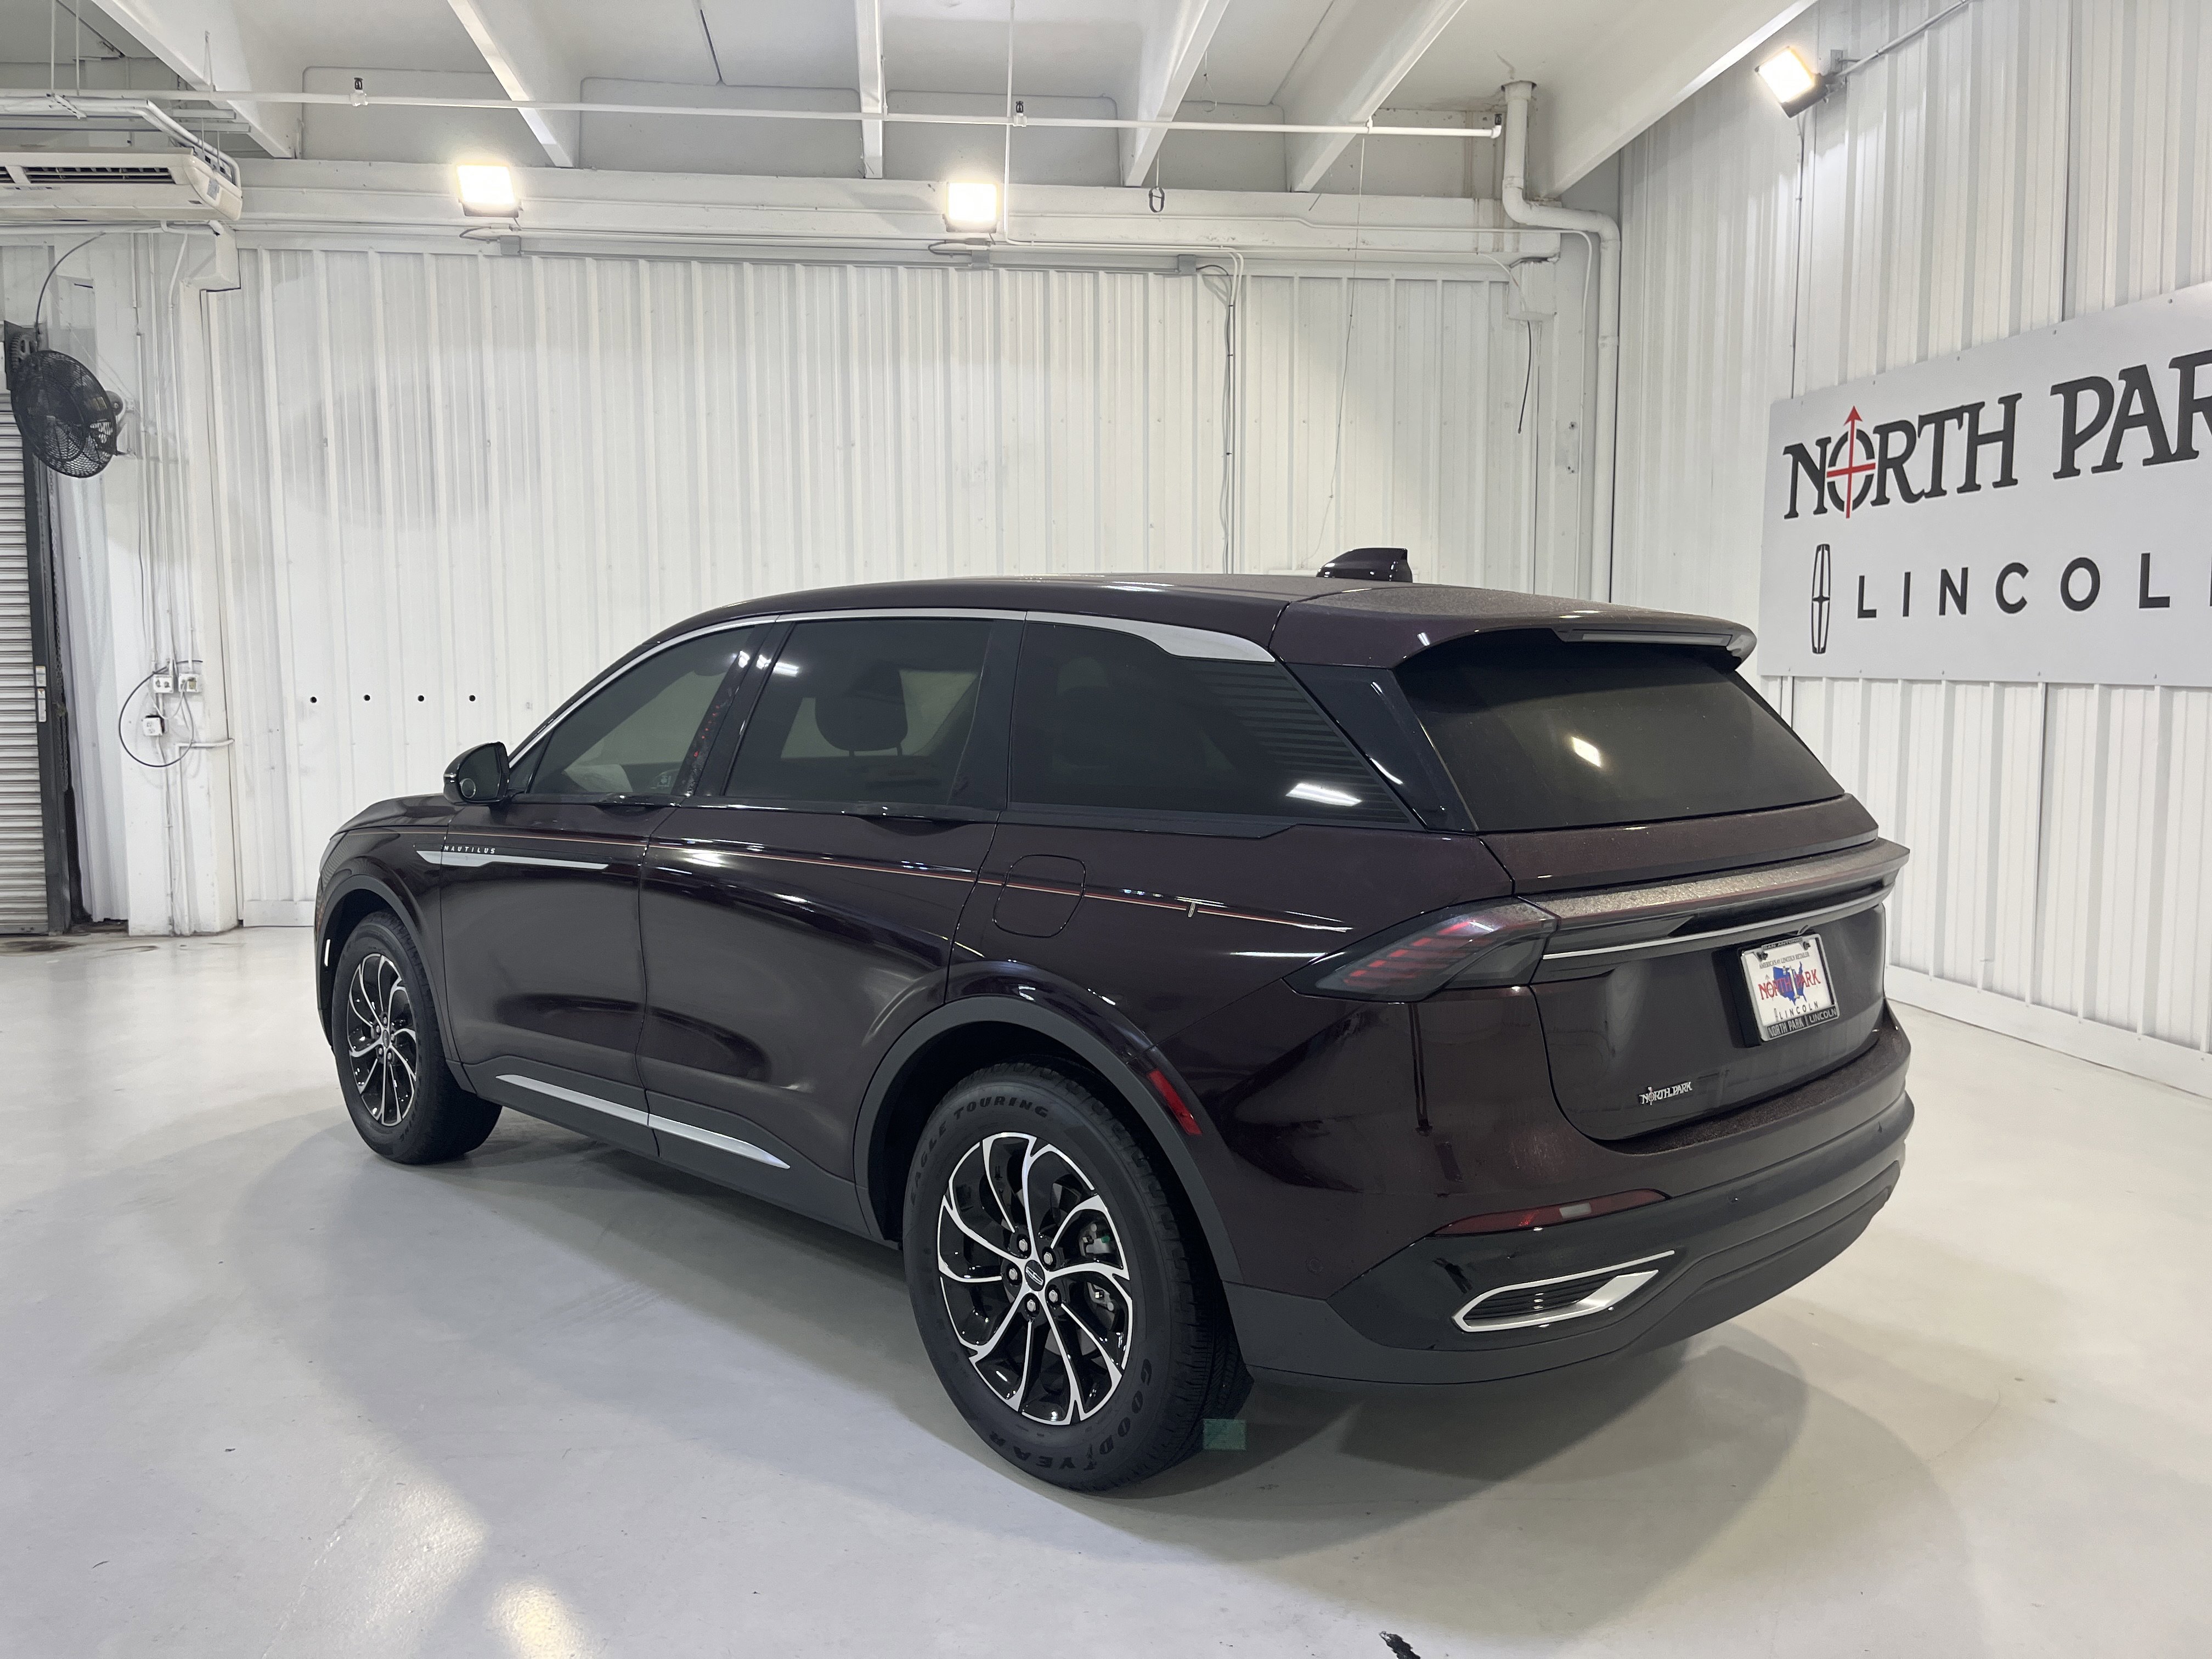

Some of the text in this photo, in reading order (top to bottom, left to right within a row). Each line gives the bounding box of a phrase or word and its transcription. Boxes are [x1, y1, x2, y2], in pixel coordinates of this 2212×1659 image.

[1782, 392, 2023, 520] NORTH
[1857, 551, 2212, 619] LINCOL
[444, 845, 495, 854] NAUTILUS
[1758, 969, 1821, 1000] NORTH PARK
[1768, 1008, 1838, 1037] NORTH PARK LINCOLN
[1779, 1001, 1819, 1020] LINCOLN
[1639, 1081, 1693, 1105] NORTH PARK
[953, 1096, 1049, 1120] TOURING
